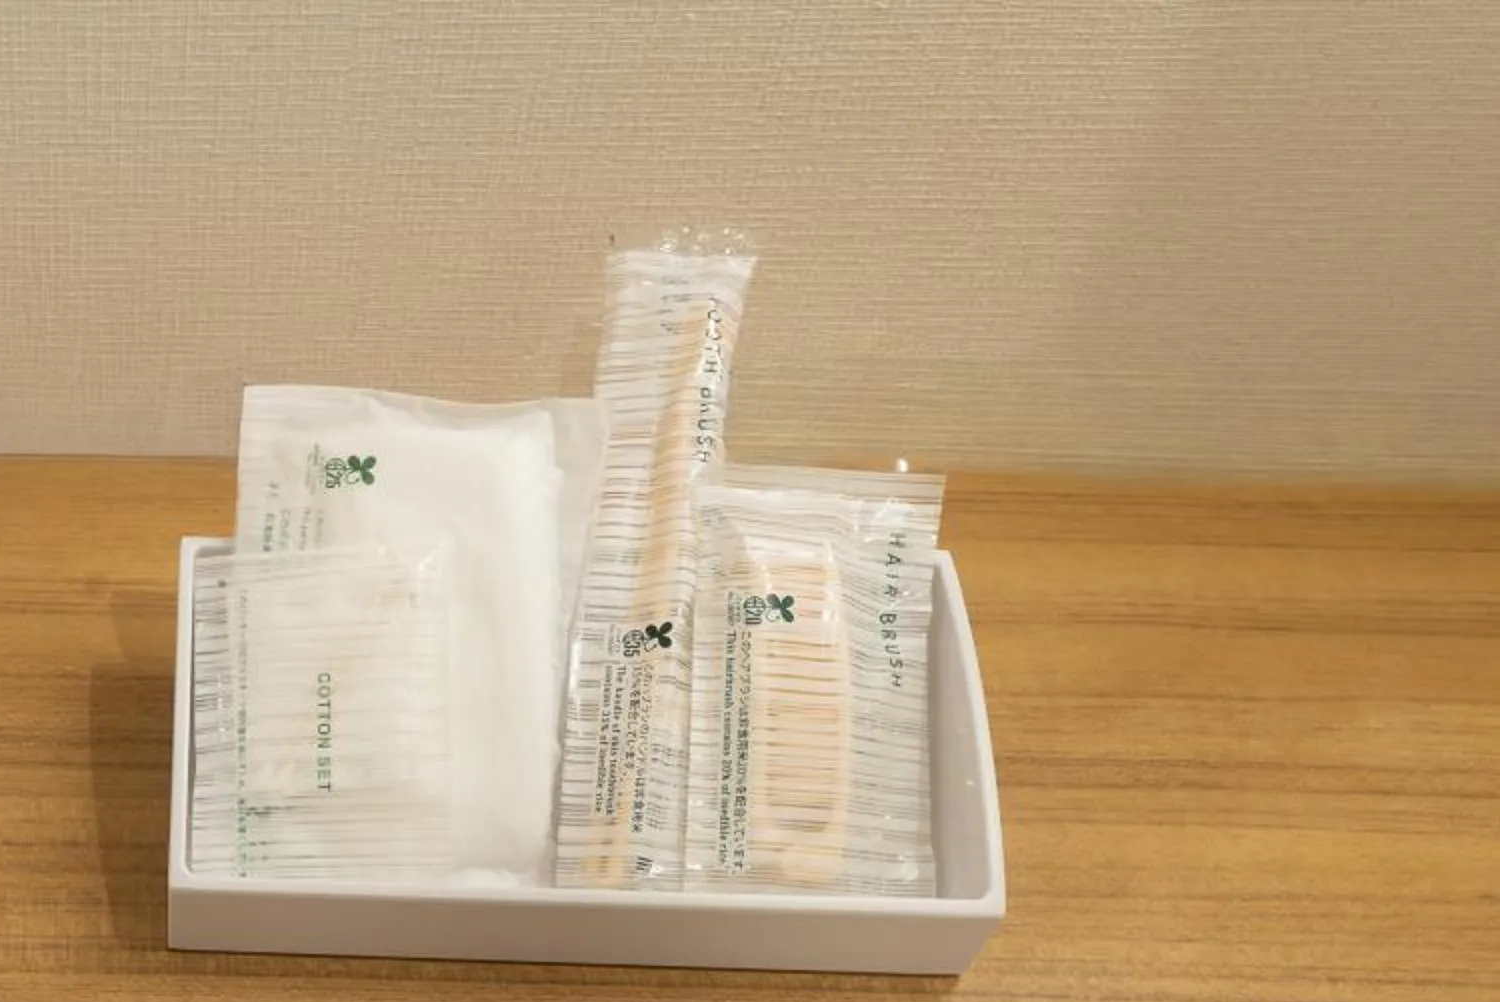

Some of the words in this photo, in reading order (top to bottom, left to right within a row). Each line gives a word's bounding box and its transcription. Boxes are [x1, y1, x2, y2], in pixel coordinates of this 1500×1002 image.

[884, 532, 906, 597] HAIR
[745, 608, 763, 626] 20
[623, 641, 641, 658] 35
[726, 629, 738, 655] This
[879, 612, 904, 688] BRUSH
[616, 666, 627, 684] The
[724, 657, 736, 709] hairbrush
[316, 672, 331, 749] COTTON
[613, 687, 625, 721] handle
[601, 710, 611, 732] 35%
[723, 711, 733, 757] contains
[611, 736, 621, 757] this
[316, 756, 331, 792] SET
[722, 759, 732, 781] 20%
